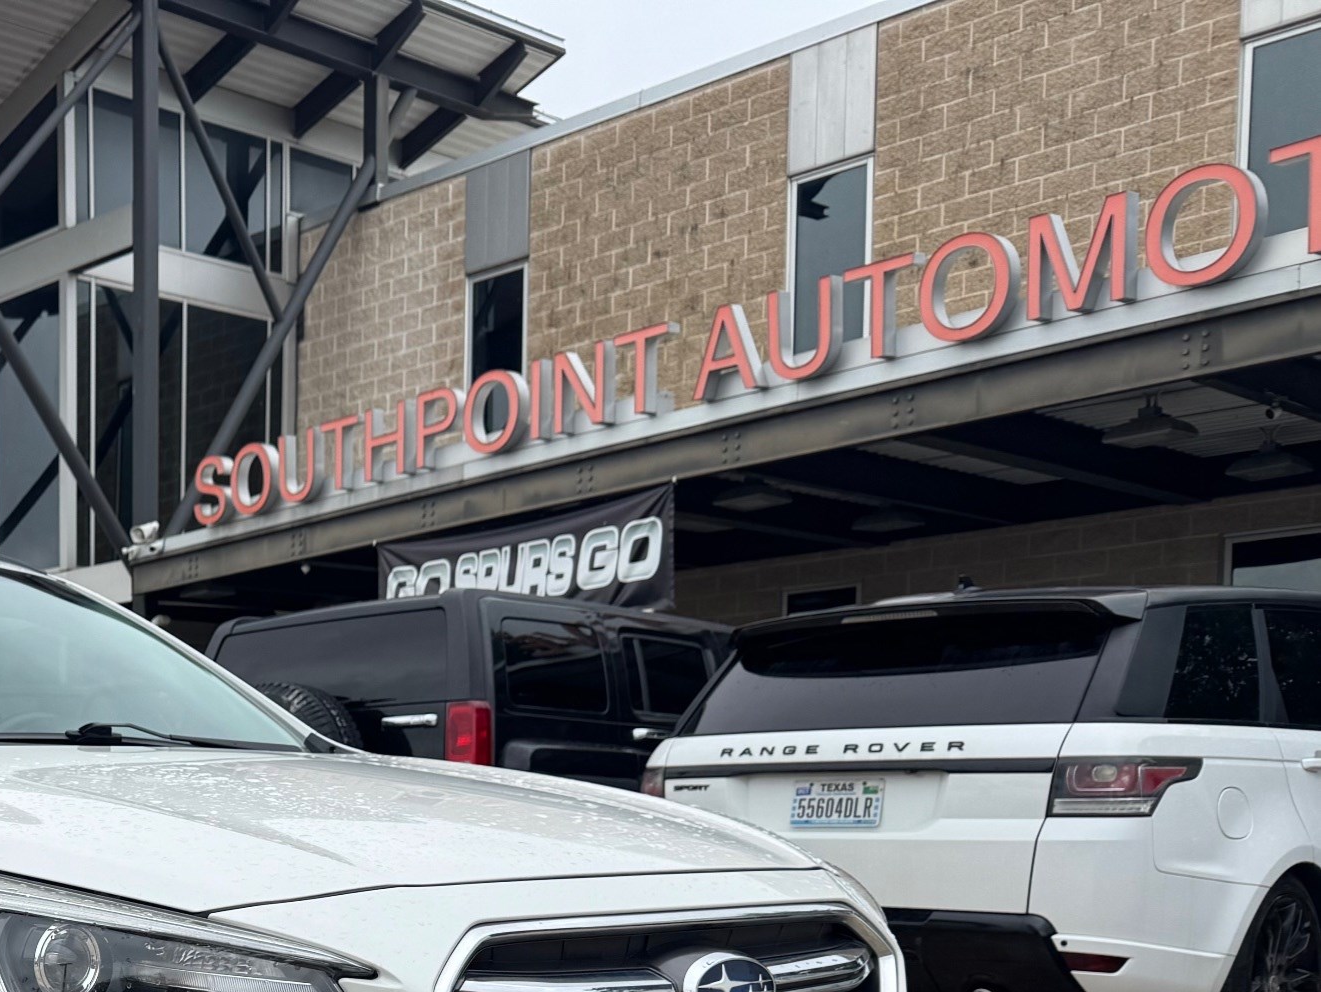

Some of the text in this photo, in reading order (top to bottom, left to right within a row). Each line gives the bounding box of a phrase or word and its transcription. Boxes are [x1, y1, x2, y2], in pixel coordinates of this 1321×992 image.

[194, 321, 677, 526] SOUTHPOINT
[386, 516, 662, 600] GO SPURS GO
[720, 741, 965, 758] RANGE ROVER
[820, 782, 855, 793] TEXAS
[796, 797, 874, 819] 55604DLR
